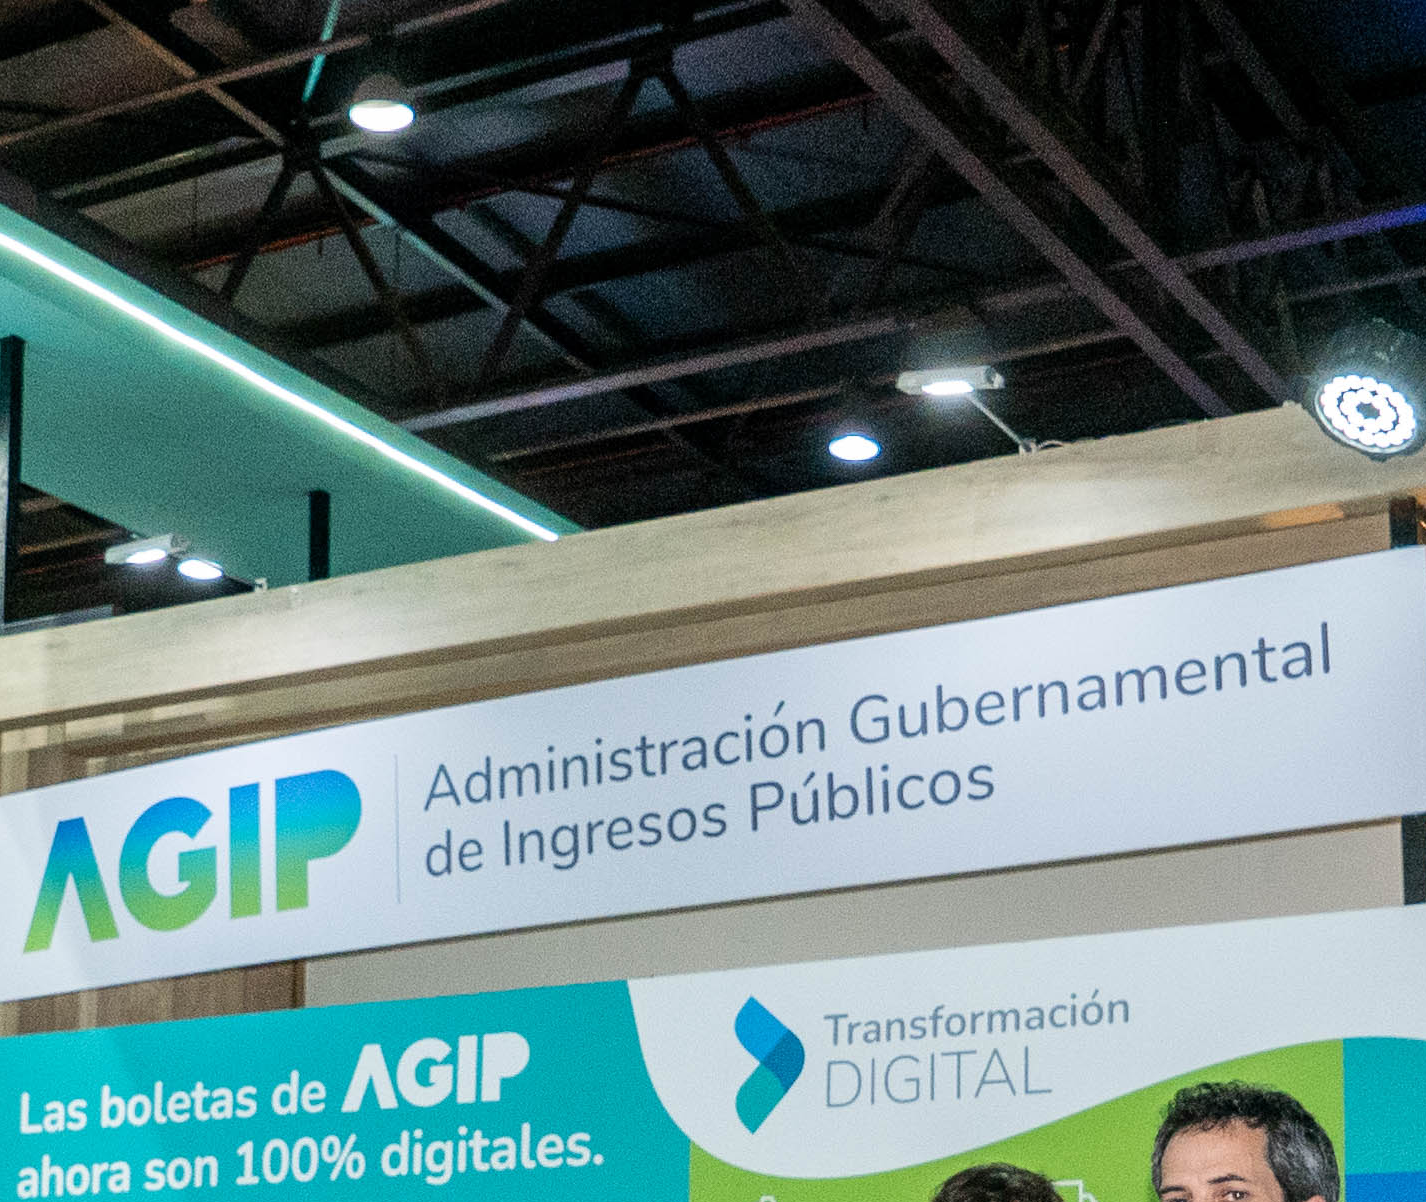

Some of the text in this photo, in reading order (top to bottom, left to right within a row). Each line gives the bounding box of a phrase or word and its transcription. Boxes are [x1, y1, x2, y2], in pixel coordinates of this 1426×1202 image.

[424, 622, 1333, 812] Administración Gubernamental
[22, 768, 363, 955] AGIP
[425, 762, 995, 877] de Ingresos Públicos
[824, 988, 1131, 1047] Transformación
[20, 1030, 531, 1135] Las boletas de AGIP
[825, 1046, 1053, 1109] DIGITAL
[17, 1123, 605, 1200] ahora son 100% digitales.
